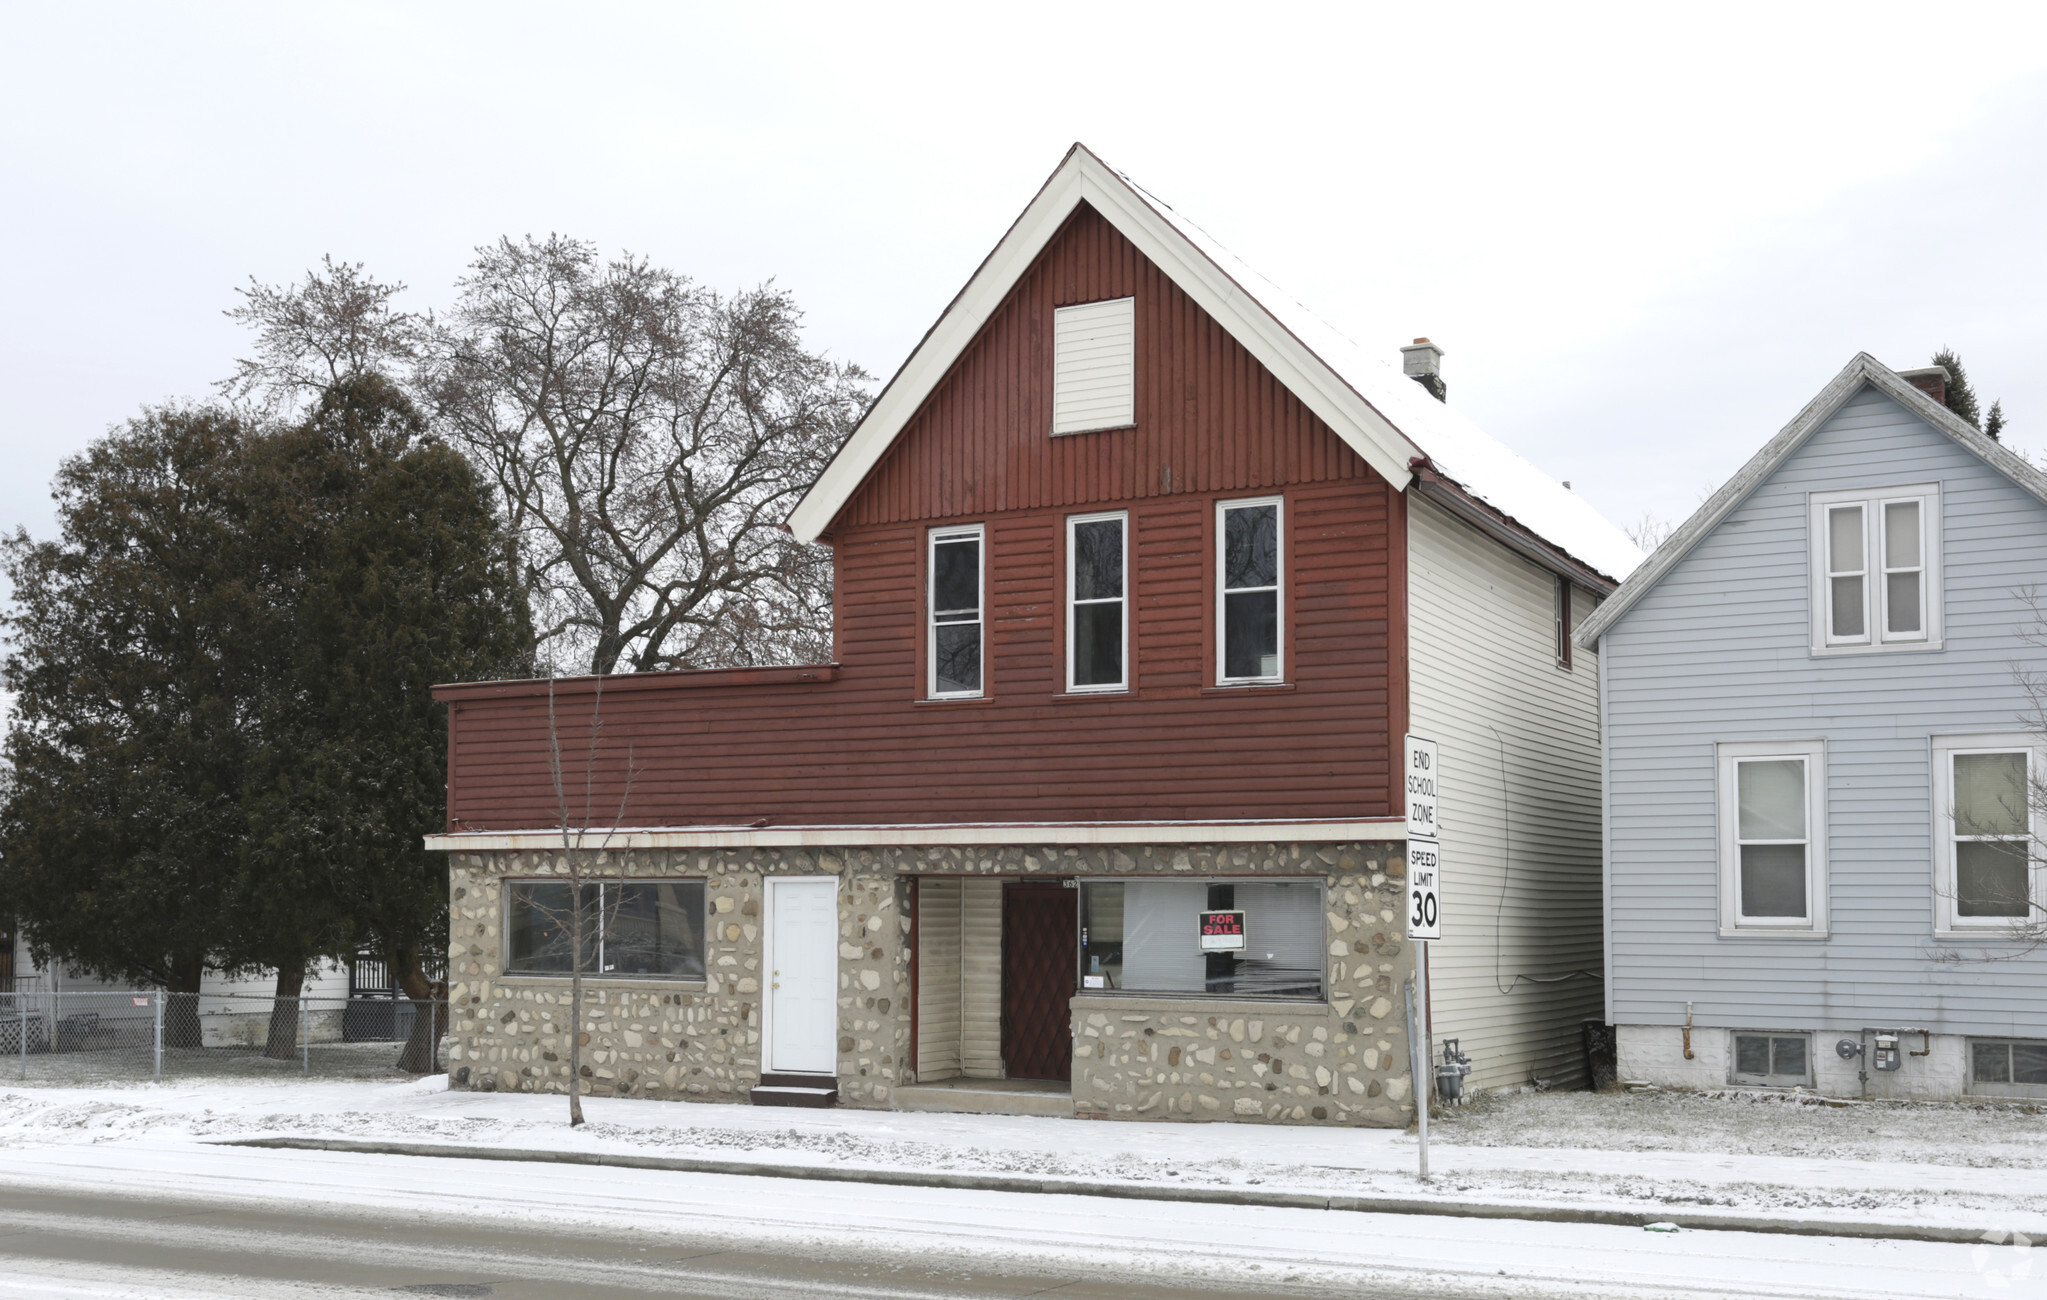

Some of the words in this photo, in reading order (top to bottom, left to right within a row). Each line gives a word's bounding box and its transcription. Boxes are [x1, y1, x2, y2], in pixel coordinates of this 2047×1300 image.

[1413, 750, 1430, 770] END
[1408, 775, 1436, 797] SCHOOL
[1412, 803, 1433, 823] ZONE
[1411, 850, 1437, 867] SPEED
[1413, 871, 1433, 887] LIMIT
[1411, 890, 1437, 928] 30
[1209, 914, 1234, 924] FOR
[1203, 924, 1241, 934] SALE
